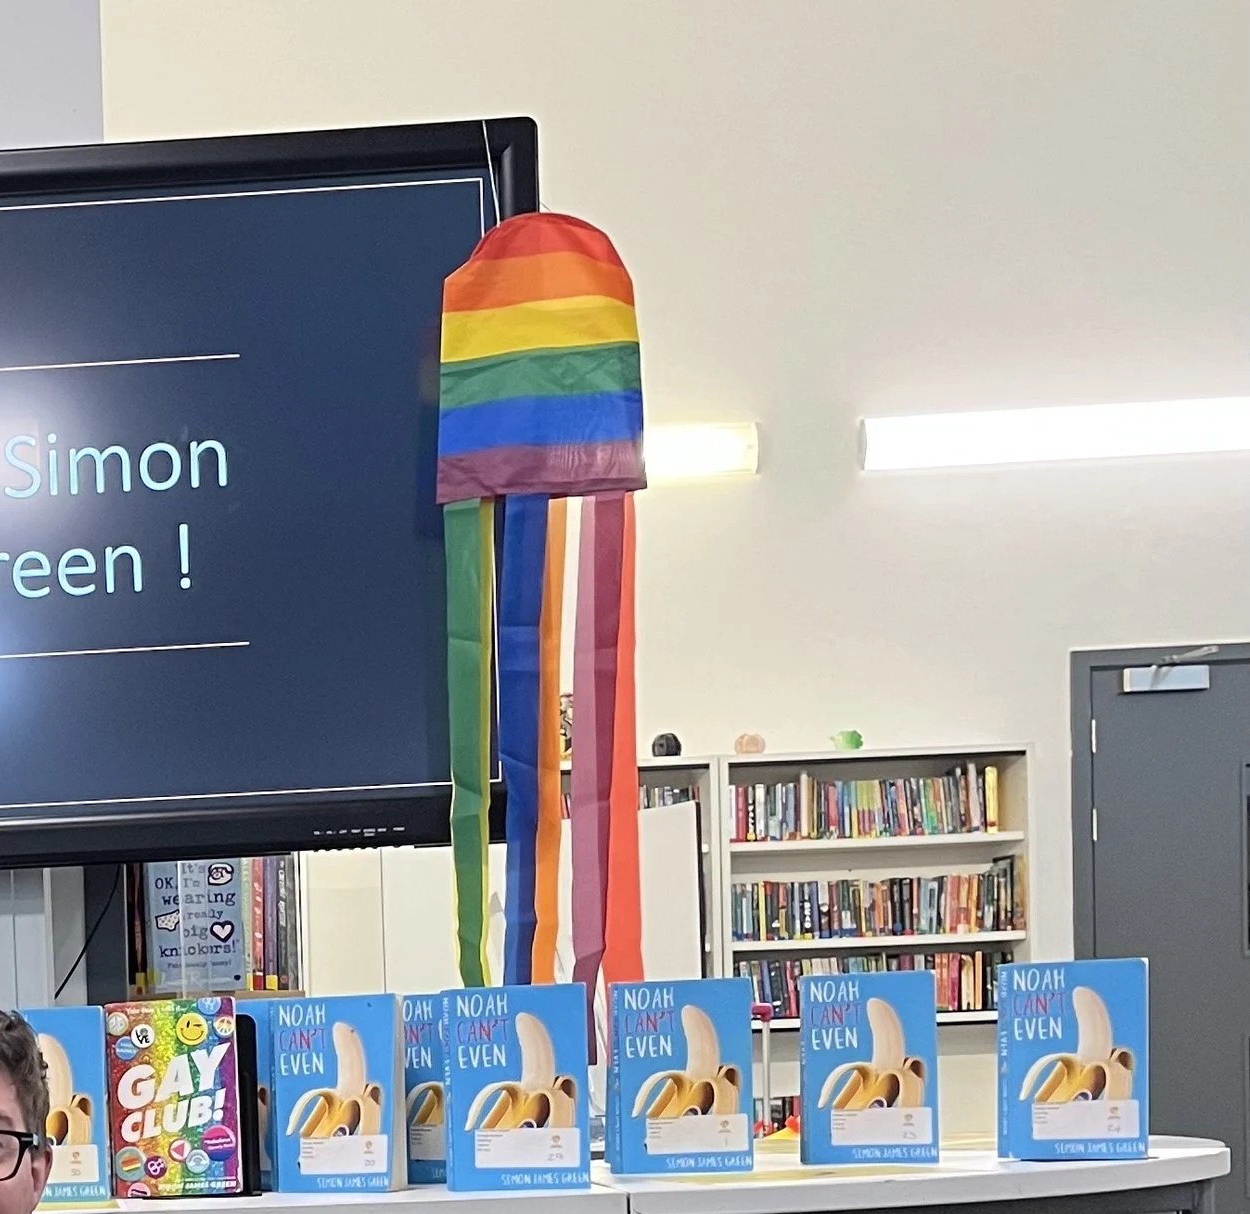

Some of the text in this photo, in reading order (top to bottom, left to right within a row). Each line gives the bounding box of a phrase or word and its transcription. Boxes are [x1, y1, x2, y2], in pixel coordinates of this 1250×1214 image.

[3, 433, 228, 499] Simon
[178, 522, 193, 590] !
[161, 888, 236, 906] wearing
[1013, 967, 1065, 991] NOAH
[624, 987, 674, 1010] NOAH
[810, 981, 859, 1002] NOAH
[279, 1003, 326, 1027] NOAH
[402, 999, 433, 1022] OAH
[457, 993, 508, 1017] NOAH
[811, 1003, 861, 1026] CAN'T
[1014, 991, 1066, 1017] CAN'T
[457, 1018, 510, 1043] CAN'T
[625, 1010, 675, 1034] CAN'T
[1014, 1017, 1062, 1040] EVEN
[280, 1028, 326, 1051] CAN'T
[626, 1035, 672, 1059] EVEN
[812, 1027, 858, 1050] EVEN
[280, 1052, 324, 1076] EVEN
[405, 1046, 432, 1069] VEN
[458, 1044, 506, 1069] EVEN
[117, 1042, 232, 1110] GAY
[121, 1088, 226, 1143] CLUB!
[853, 1147, 937, 1159] SIMON JAMES GREEN
[1055, 1142, 1145, 1154] SIMON JAMES GREEN
[666, 1155, 752, 1169] SIMON JAMES GREEN
[317, 1175, 389, 1189] SIMON JAMES GREEN
[501, 1172, 589, 1185] SIMON JAMES GREEN
[53, 1186, 78, 1197] JAMES
[79, 1186, 106, 1197] GREEN
